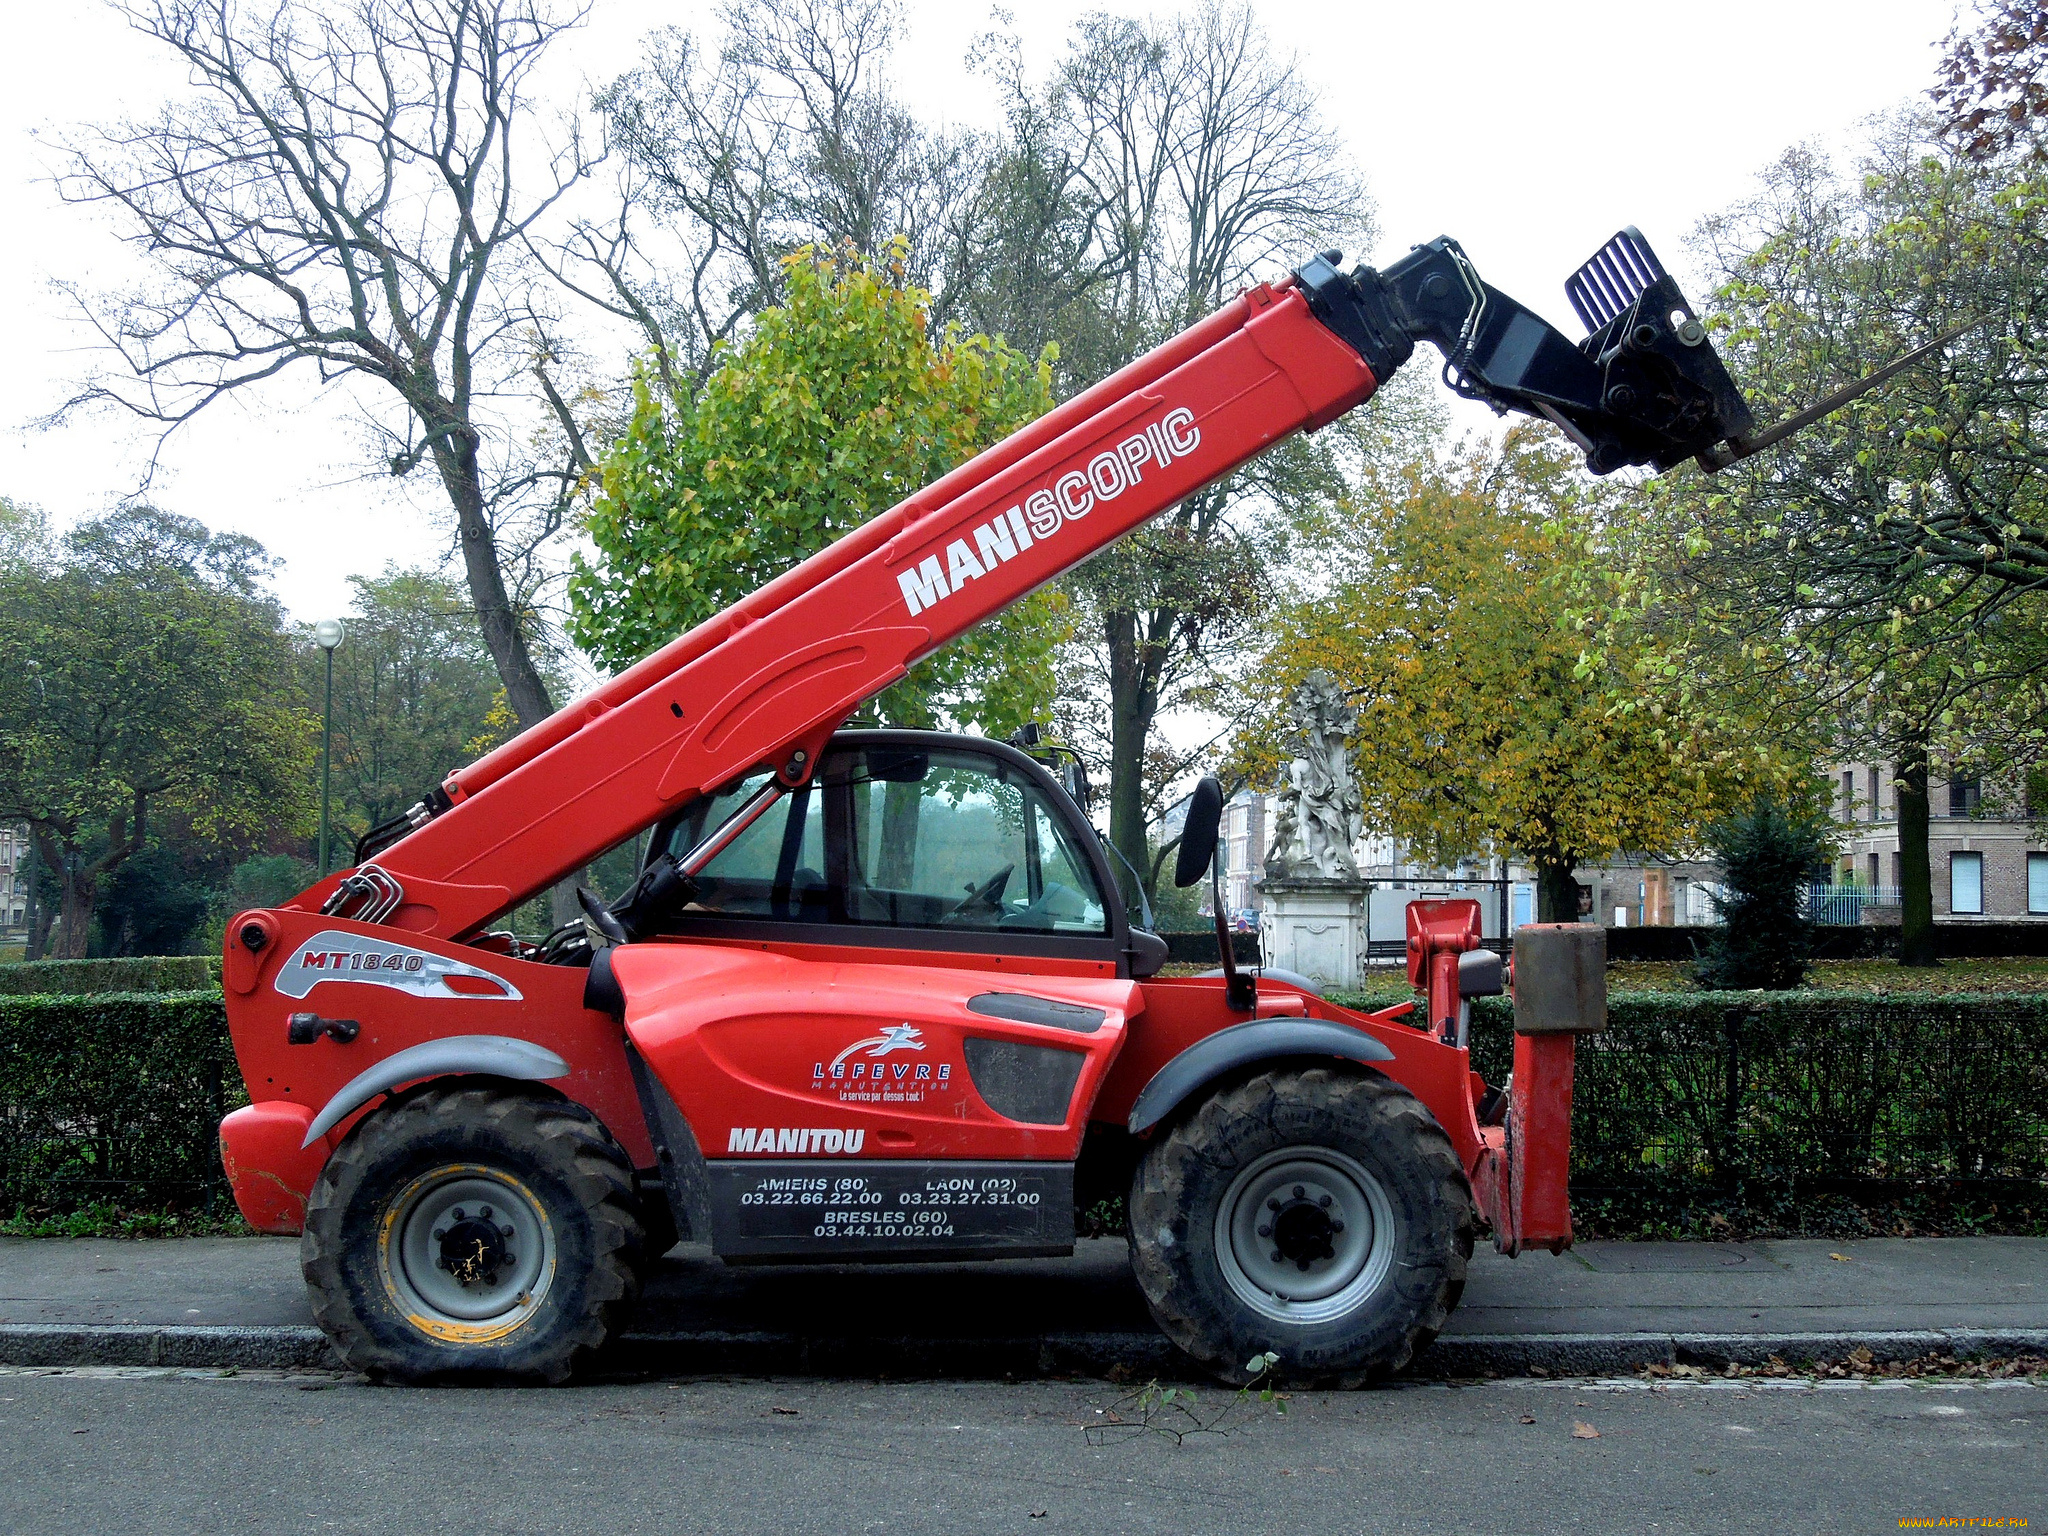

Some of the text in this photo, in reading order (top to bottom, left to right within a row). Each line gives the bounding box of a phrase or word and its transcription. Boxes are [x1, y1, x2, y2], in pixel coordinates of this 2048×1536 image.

[896, 406, 1201, 617] MANISCOPIC
[301, 950, 424, 972] MT1840
[813, 1063, 951, 1079] LEFEVRE
[811, 1081, 948, 1091] MANUTENTION
[839, 1090, 848, 1101] Le
[848, 1091, 871, 1102] service
[871, 1092, 881, 1103] par
[883, 1091, 905, 1102] dessus
[727, 1128, 865, 1154] MANITOU
[756, 1178, 869, 1193] AMIENS (80)
[925, 1178, 1017, 1193] LAON (02)
[741, 1192, 882, 1205] 03.22.66.22.00
[899, 1192, 1040, 1205] 03.23.27.31.00
[824, 1211, 948, 1225] BRESLES (60)
[814, 1225, 955, 1237] 03.44.10.02.04
